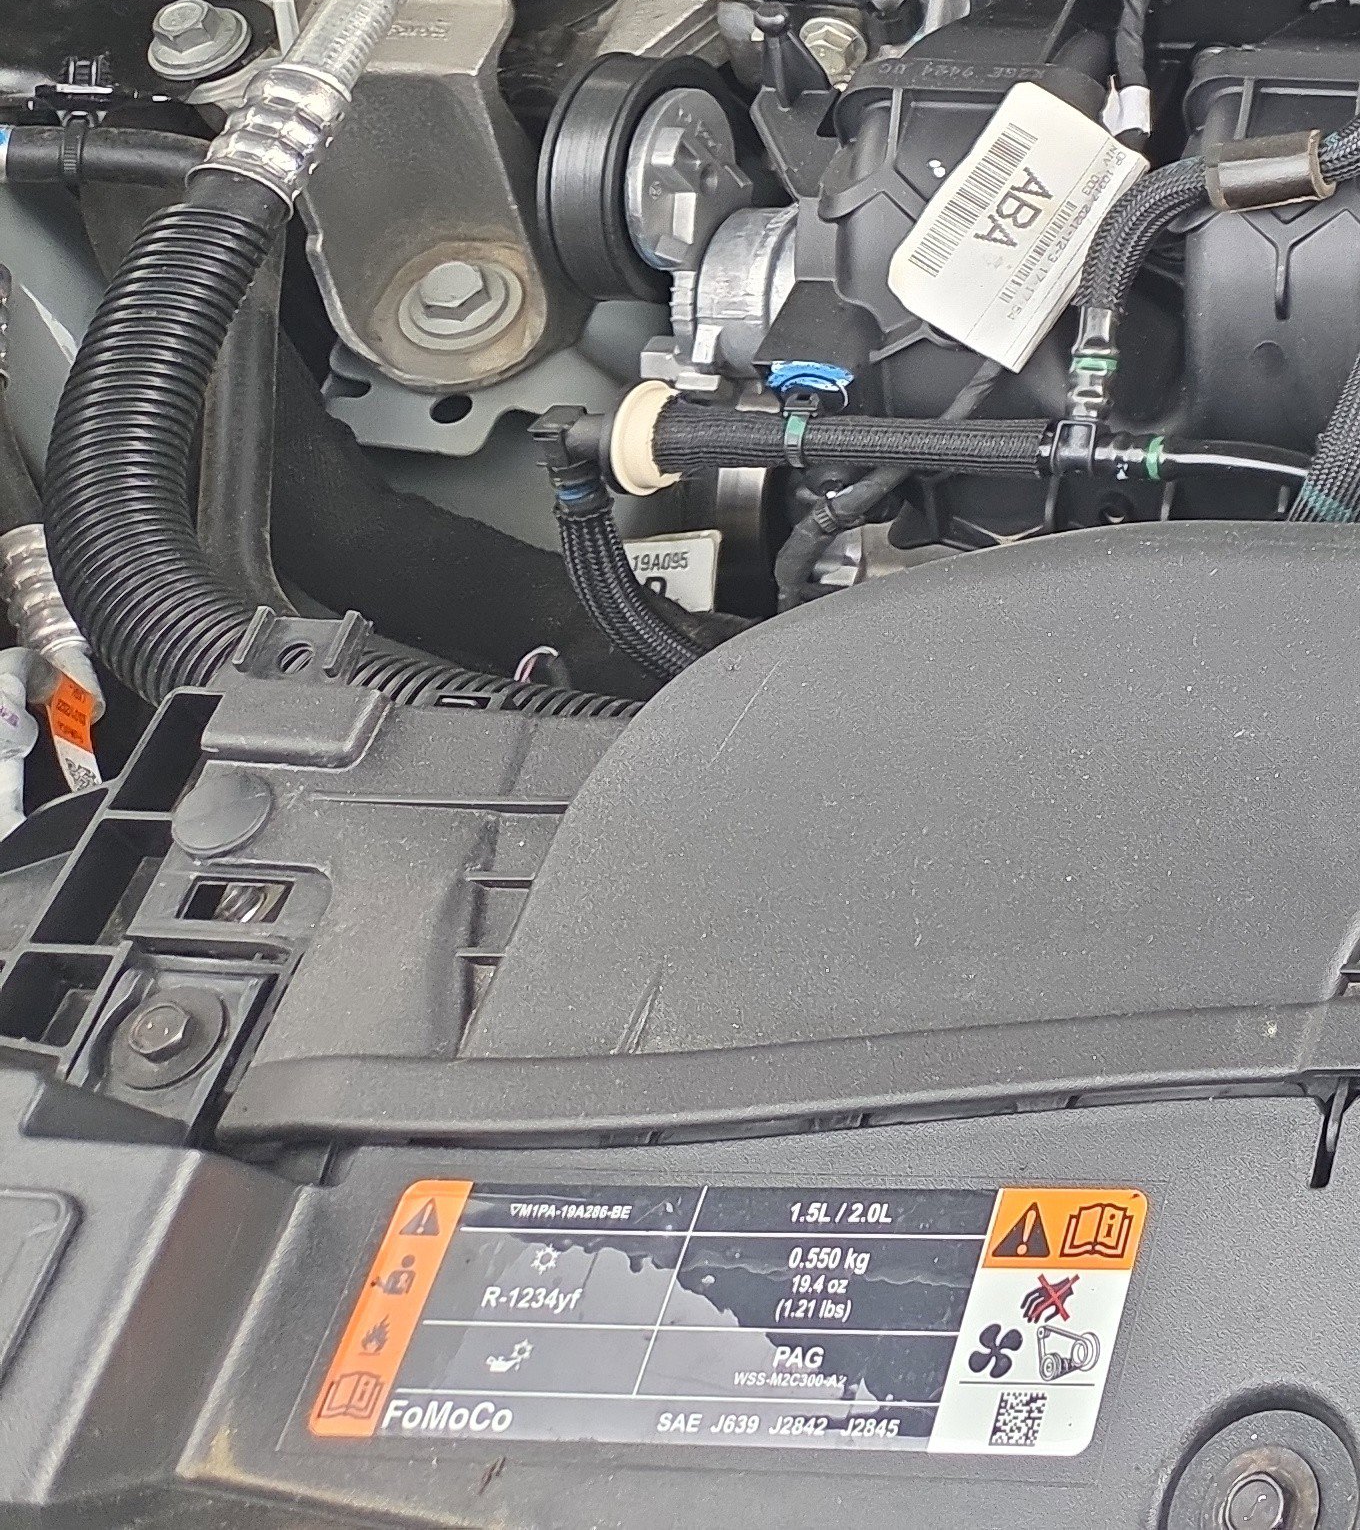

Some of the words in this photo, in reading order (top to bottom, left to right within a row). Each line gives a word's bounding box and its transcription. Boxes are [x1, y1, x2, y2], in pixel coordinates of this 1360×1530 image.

[973, 166, 1054, 248] ABA
[631, 550, 690, 572] 19A095
[790, 1202, 832, 1224] 1.5L
[833, 1203, 848, 1224] /
[848, 1202, 893, 1224] 2.0L
[788, 1246, 842, 1270] 0.550
[843, 1247, 871, 1276] kg
[791, 1274, 824, 1293] 19.4
[826, 1279, 849, 1294] oz
[480, 1286, 584, 1315] R-1234yf
[775, 1298, 815, 1322] (1.21
[819, 1299, 853, 1322] lbs)
[772, 1346, 826, 1369] PAG
[380, 1399, 514, 1433] FoMoCo
[656, 1412, 703, 1433] SAE
[709, 1414, 761, 1435] J639
[767, 1416, 829, 1437] J2842
[840, 1417, 901, 1439] J2845
